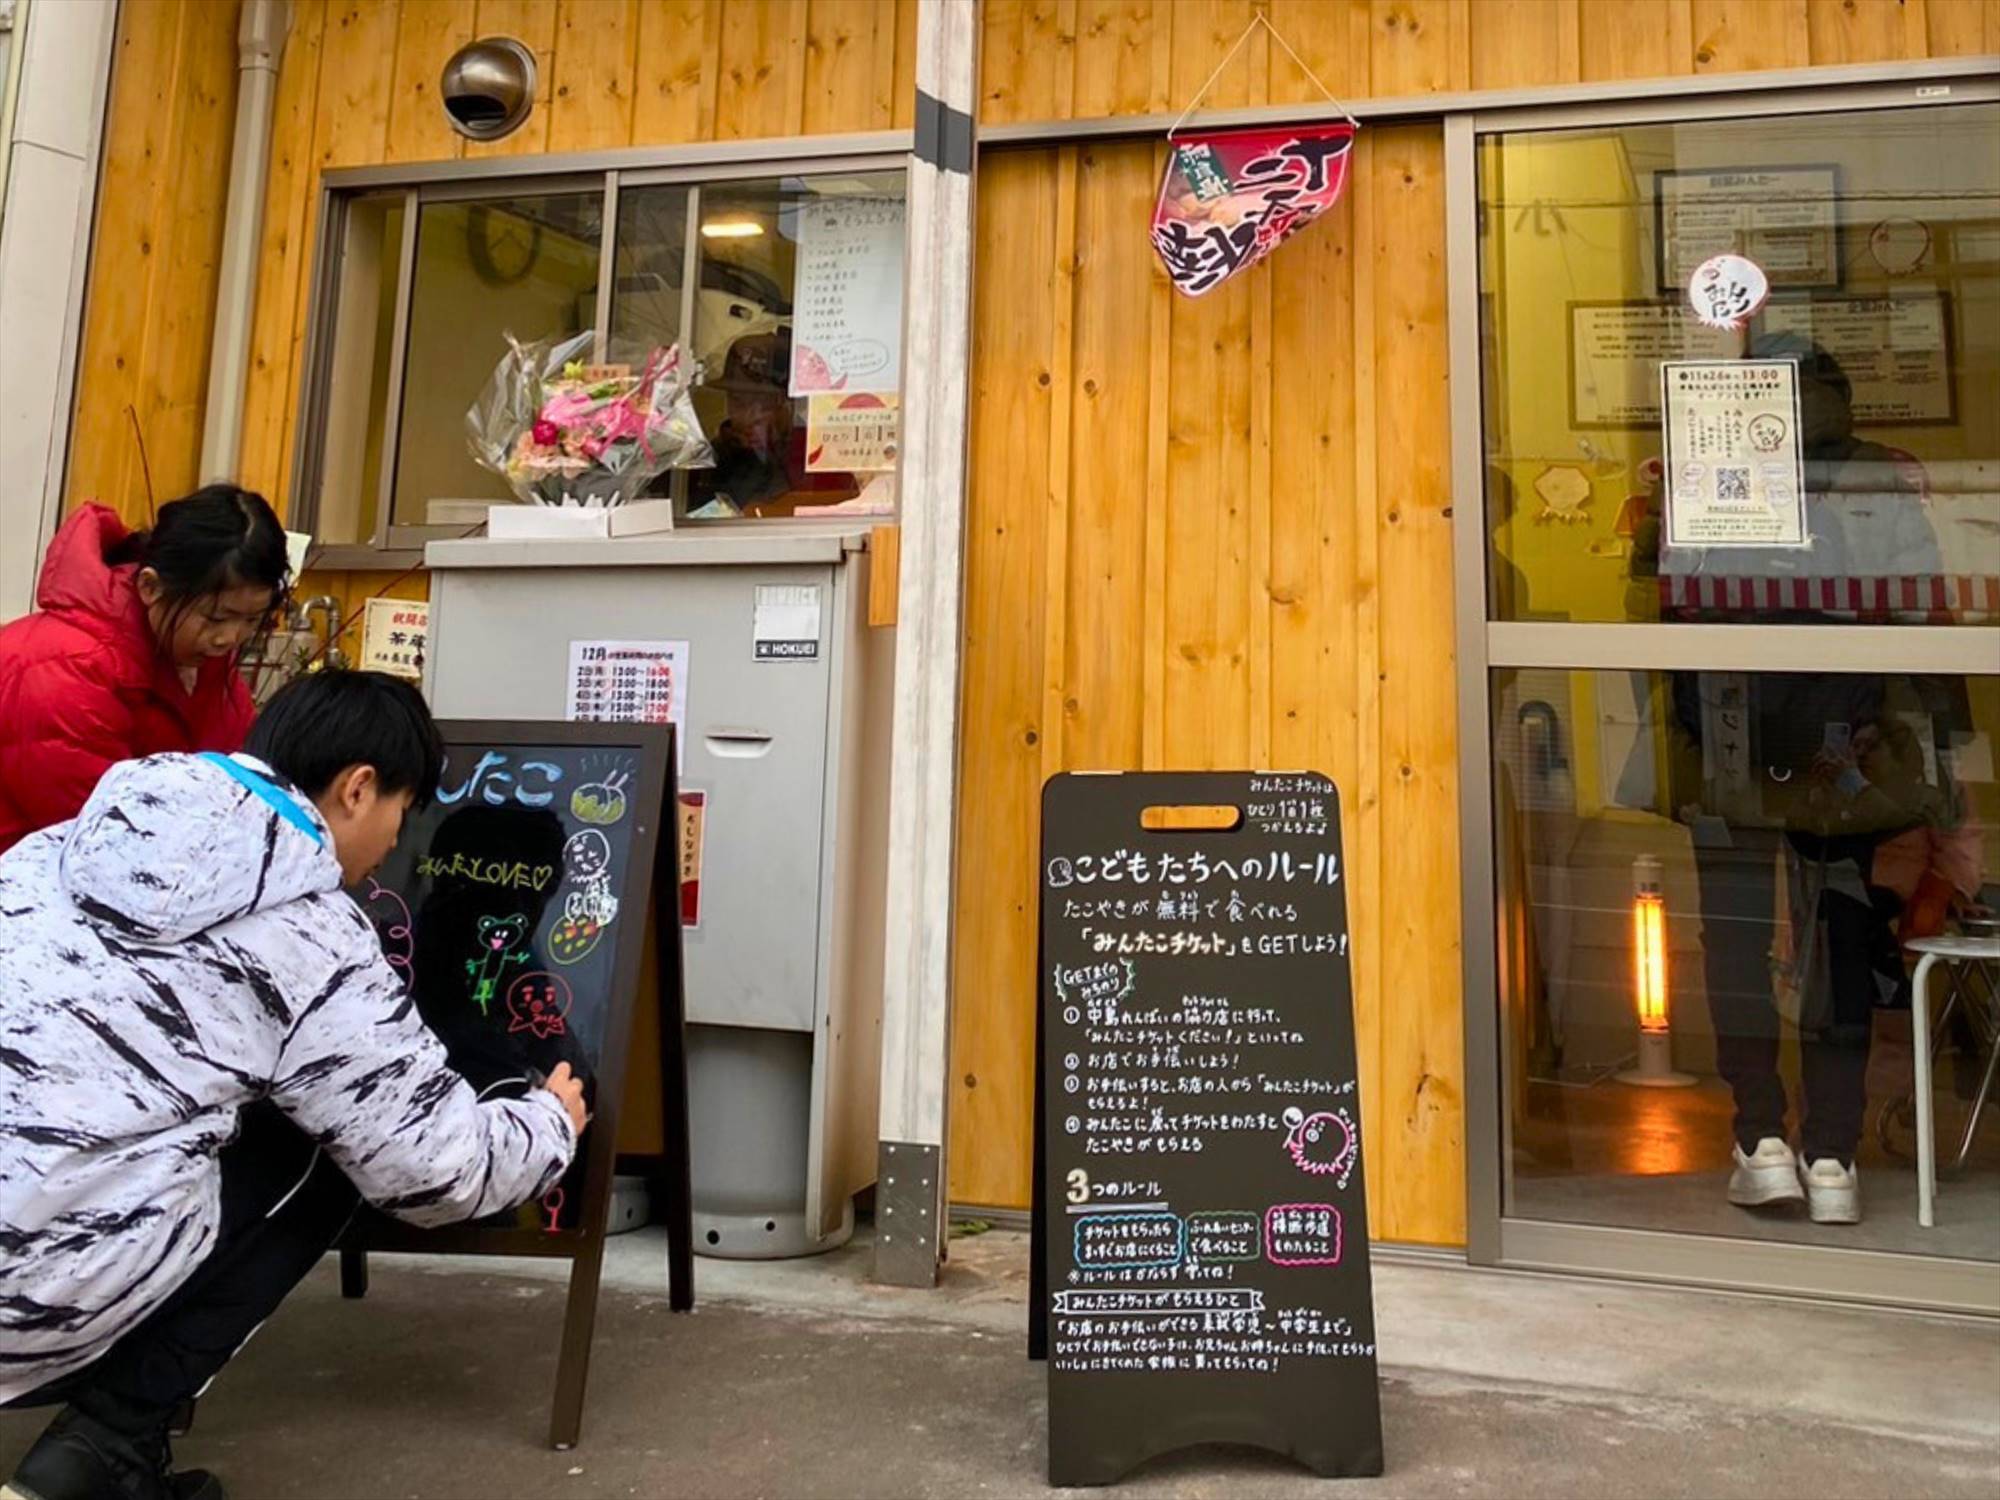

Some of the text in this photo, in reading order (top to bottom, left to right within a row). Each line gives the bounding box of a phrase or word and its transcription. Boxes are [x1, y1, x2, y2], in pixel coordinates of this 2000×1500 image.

[1075, 849, 1340, 886] こどもたちへのルール
[1066, 1167, 1163, 1204] 3つのルール
